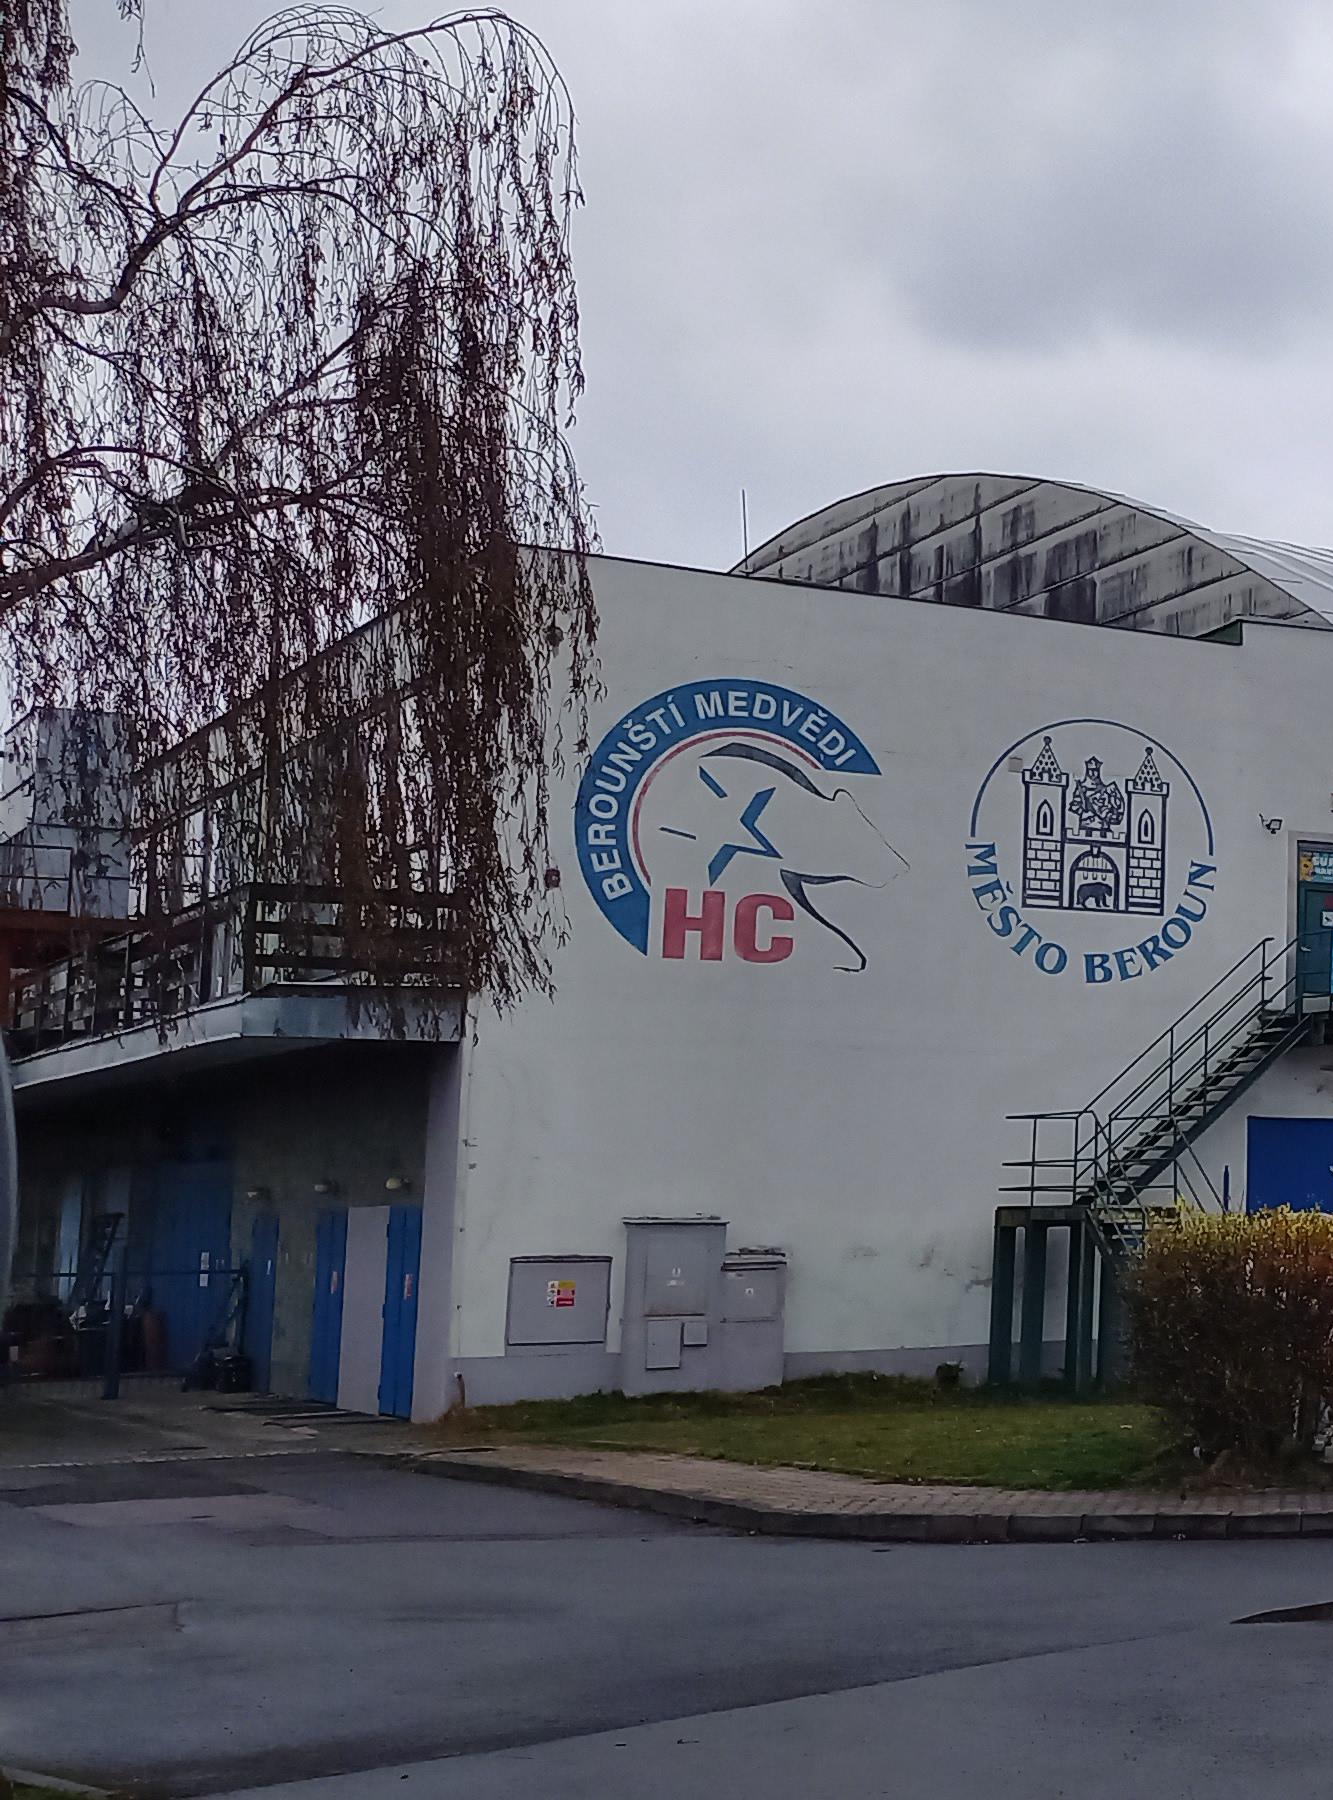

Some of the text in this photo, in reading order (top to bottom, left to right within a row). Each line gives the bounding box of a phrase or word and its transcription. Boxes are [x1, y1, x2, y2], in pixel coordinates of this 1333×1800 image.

[588, 690, 857, 900] BEROUNŠTÍ MEDVĚDI
[661, 887, 795, 964] HC
[965, 842, 1218, 984] MĚSTO BEROUN
